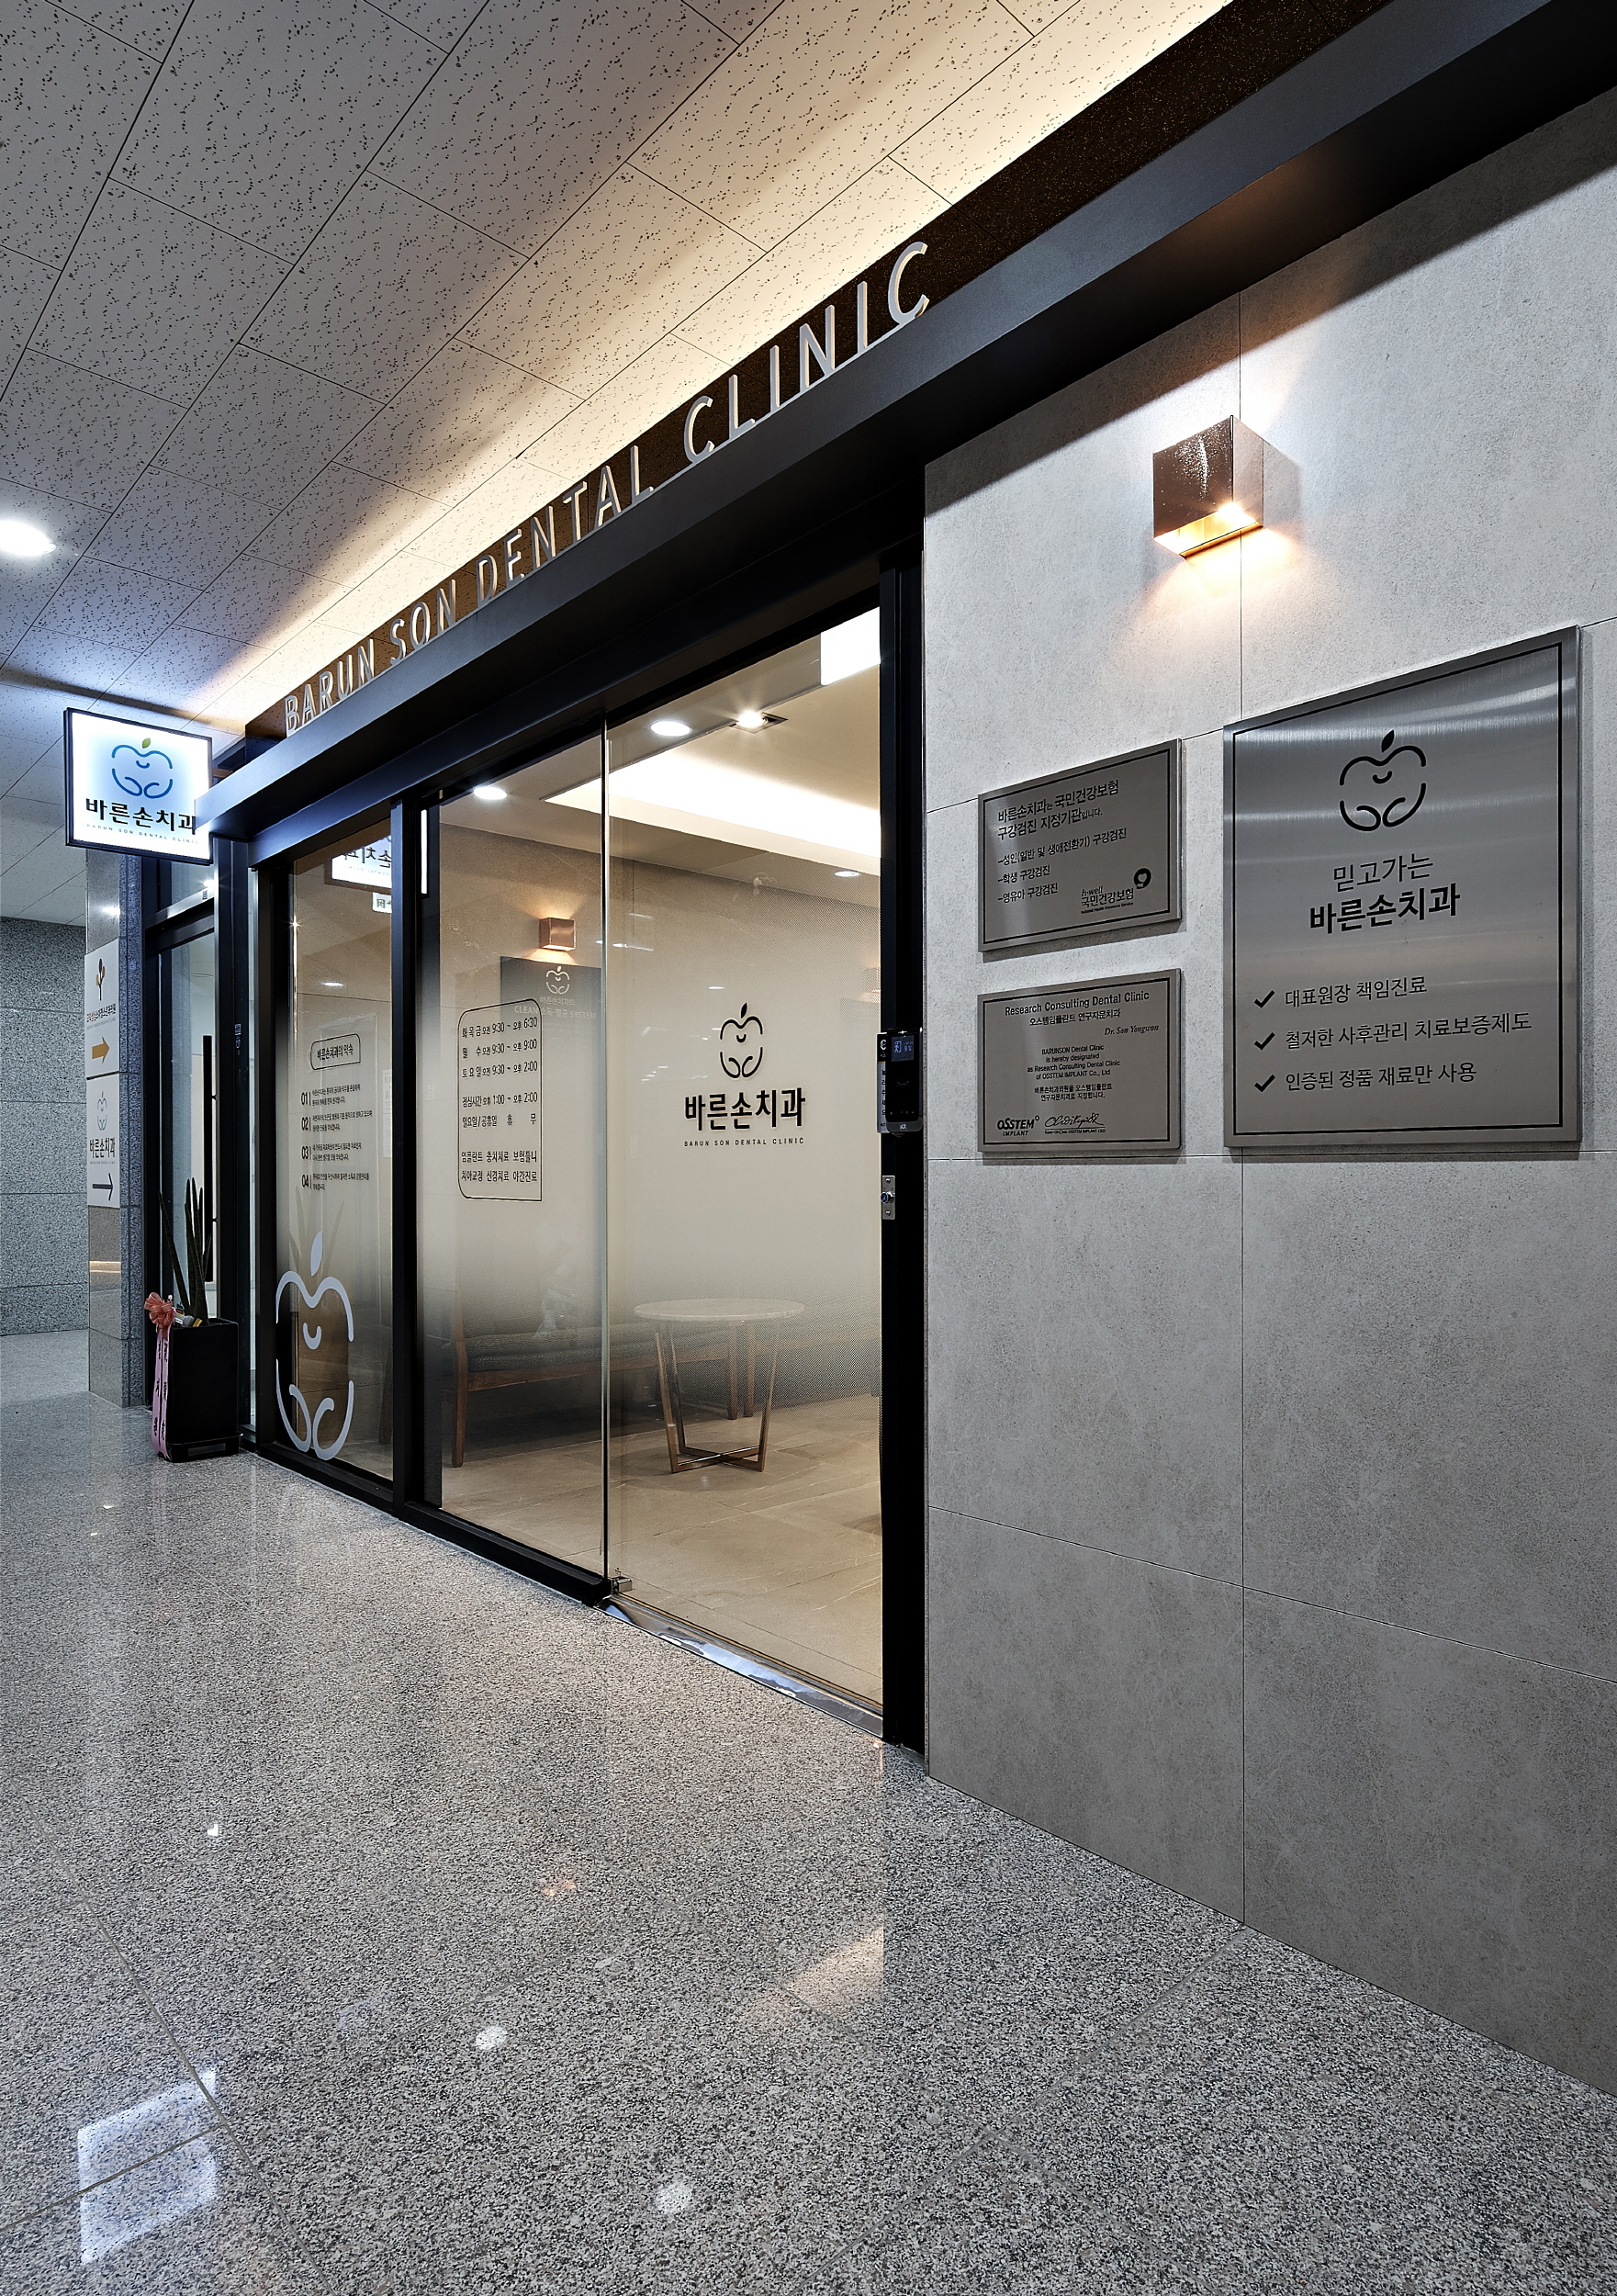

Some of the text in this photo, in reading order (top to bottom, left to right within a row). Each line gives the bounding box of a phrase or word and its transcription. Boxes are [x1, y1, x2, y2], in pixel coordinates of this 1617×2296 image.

[284, 240, 930, 737] BARUN SON DENTAL CLINIC
[998, 780, 1118, 823] 바른손치과는 국민건강보험
[85, 798, 196, 836] 바른손치과
[998, 806, 1102, 840] 구강검진 지정기관입니다.
[1038, 847, 1045, 857] 및
[1048, 836, 1090, 855] 생애전환기)
[1093, 827, 1127, 845] 구강검진
[1020, 865, 1050, 880] 구강검진
[1333, 852, 1433, 893] 믿고가는
[1027, 883, 1058, 898] 구강검진
[1082, 888, 1133, 907] 국민건강보험
[1308, 883, 1461, 935] 바른손치과
[1285, 976, 1428, 1008] 대표원장 책임진료
[1005, 990, 1150, 1017] Research Consulting Dental Clinic
[524, 1017, 537, 1028] 6:30
[1029, 1013, 1076, 1026] 오스템임플란트
[1105, 1027, 1115, 1036] Dr.
[1116, 1026, 1128, 1034] Son
[1286, 1012, 1533, 1050] 철저한 사후관리 치료보증제도
[524, 1039, 537, 1051] 9:00
[1041, 1043, 1104, 1055] BARUNSON Dental Clinic
[1051, 1054, 1069, 1064] hereby
[1071, 1052, 1100, 1062] designated
[524, 1061, 537, 1072] 2:00
[1034, 1064, 1058, 1072] Research
[1059, 1062, 1085, 1072] Consulting
[1086, 1060, 1104, 1068] Dental
[1105, 1059, 1120, 1067] Clinic
[1042, 1071, 1063, 1079] OSSTEM
[1064, 1069, 1087, 1077] IMPLANT
[1285, 1061, 1477, 1092] 인증된 정품 재료만 사용
[1075, 1083, 1113, 1092] 오스템임플란트
[301, 1092, 309, 1106] 01
[462, 1096, 482, 1108] 점심시간
[524, 1092, 537, 1103] 2:00
[684, 1087, 806, 1131] 바른손치과
[301, 1117, 309, 1131] 02
[90, 1137, 115, 1158] 바른손치과
[772, 1137, 804, 1145] CLINIC
[301, 1146, 309, 1160] 03
[462, 1151, 537, 1163] 임플란트 충치치료 보험틀니
[302, 1175, 309, 1187] 04
[487, 1170, 510, 1182] 신경치료
[513, 1170, 537, 1183] 야간진료
